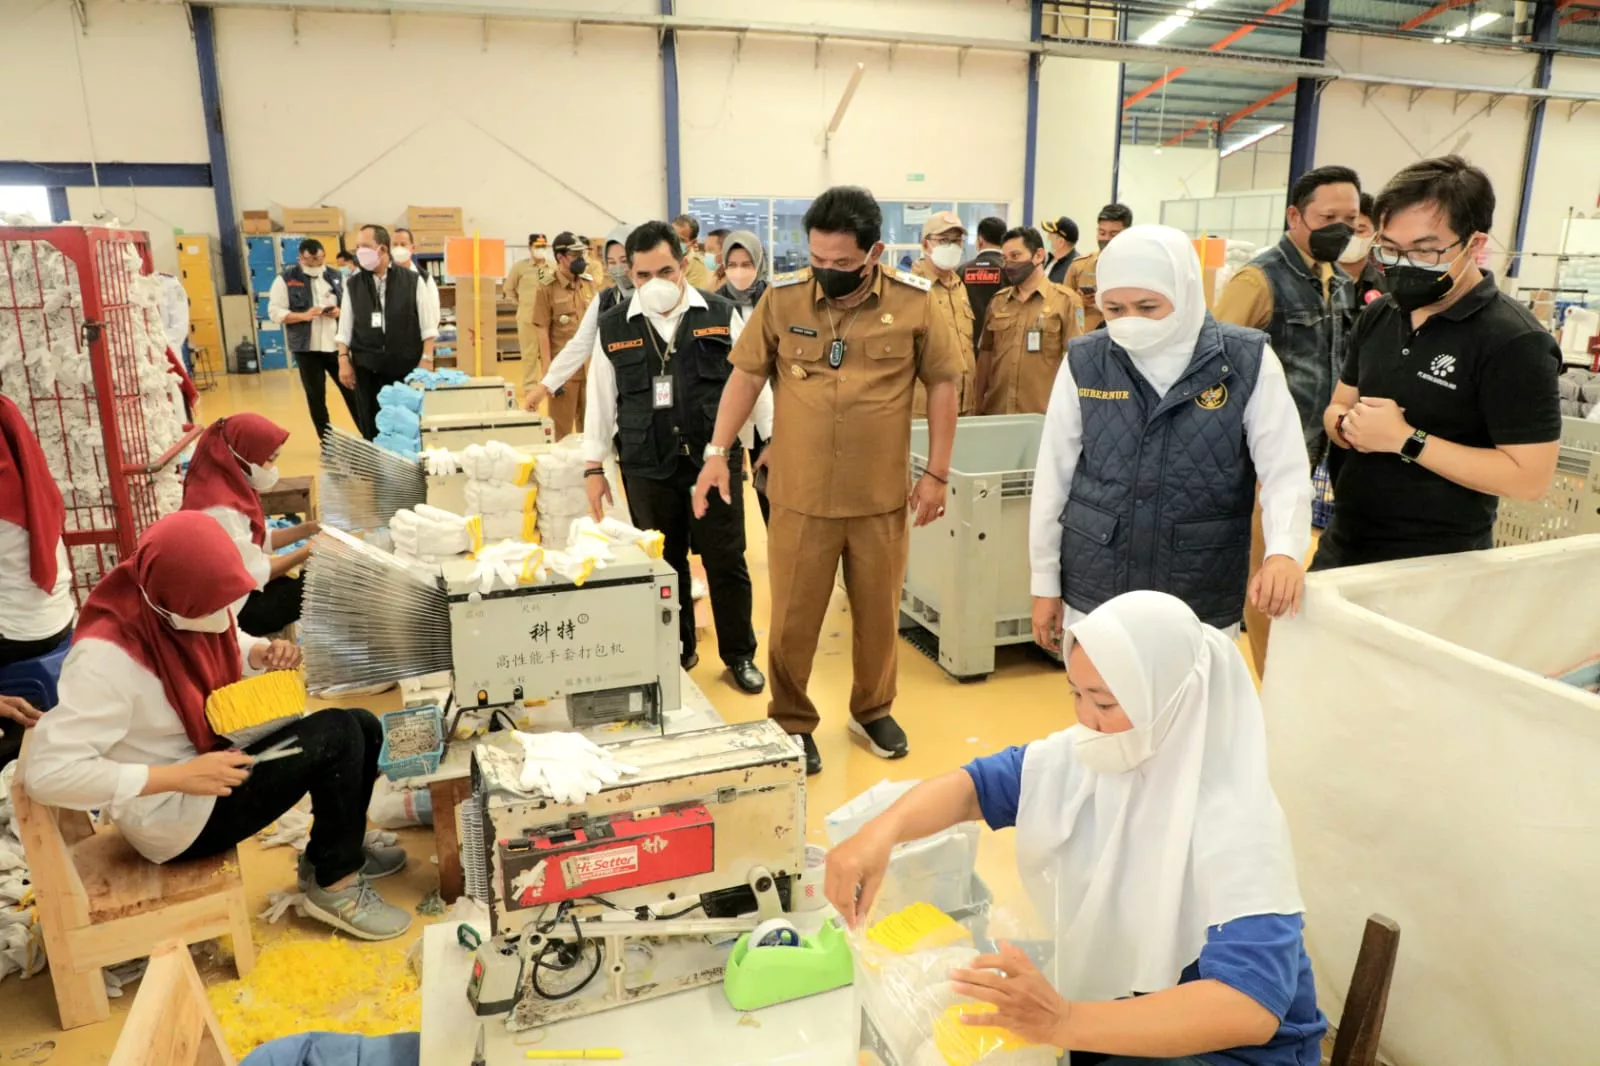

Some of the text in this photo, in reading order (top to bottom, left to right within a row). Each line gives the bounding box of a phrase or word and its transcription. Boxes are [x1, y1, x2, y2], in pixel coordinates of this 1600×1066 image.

[1078, 387, 1129, 399] GUBERNUR
[528, 618, 576, 645] 科特
[496, 642, 625, 669] 高性能手套打包机
